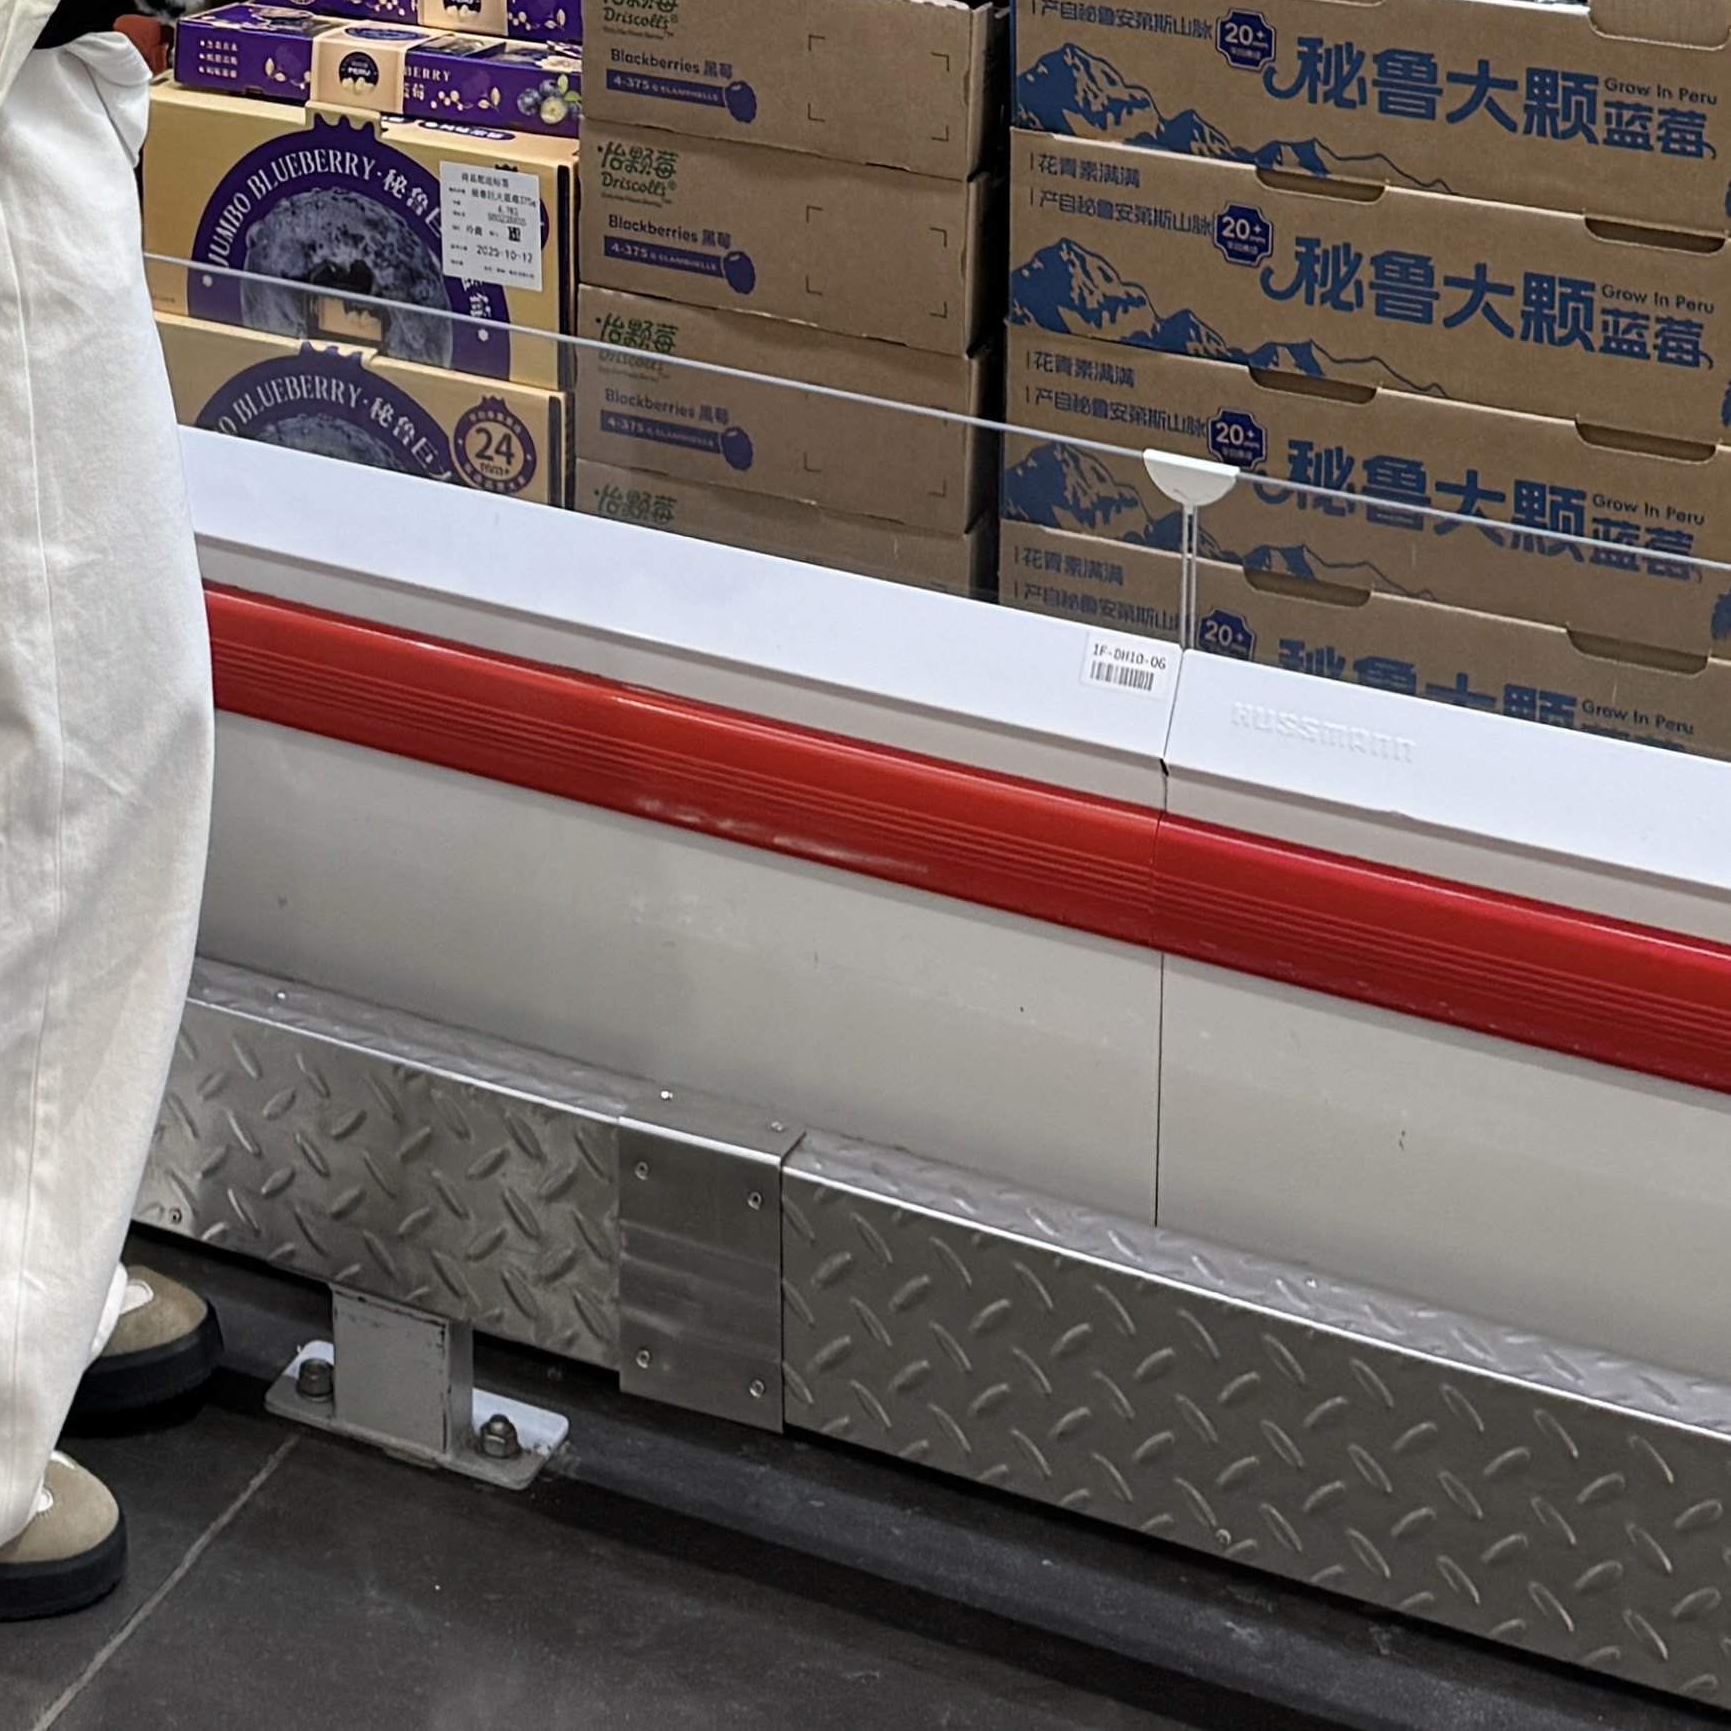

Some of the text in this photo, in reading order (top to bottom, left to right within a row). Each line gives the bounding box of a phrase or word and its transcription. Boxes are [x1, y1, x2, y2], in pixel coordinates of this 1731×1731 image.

[611, 48, 699, 74] Blackberries
[1264, 36, 1717, 161] 秘鲁大颗蓝莓
[1604, 77, 1718, 107] Grow In Peru
[597, 141, 679, 179] 怡颗莓
[1038, 154, 1141, 189] 花青素满满
[207, 191, 251, 268] JUMBO
[247, 148, 376, 200] BLUEBERRY
[609, 214, 698, 243] Blackberries
[1260, 236, 1714, 370] 秘鲁大颗蓝莓
[1601, 284, 1715, 315] Grow In Peru
[1033, 351, 1135, 387] 花青素满满
[234, 374, 360, 428] BLUEBERRY
[605, 387, 695, 418] Blackberries
[475, 427, 515, 466] 24
[1253, 438, 1702, 582] 秘鲁大颗蓝莓
[1593, 493, 1705, 527] Grow In Peru
[1582, 699, 1694, 736] Grow In Peru
